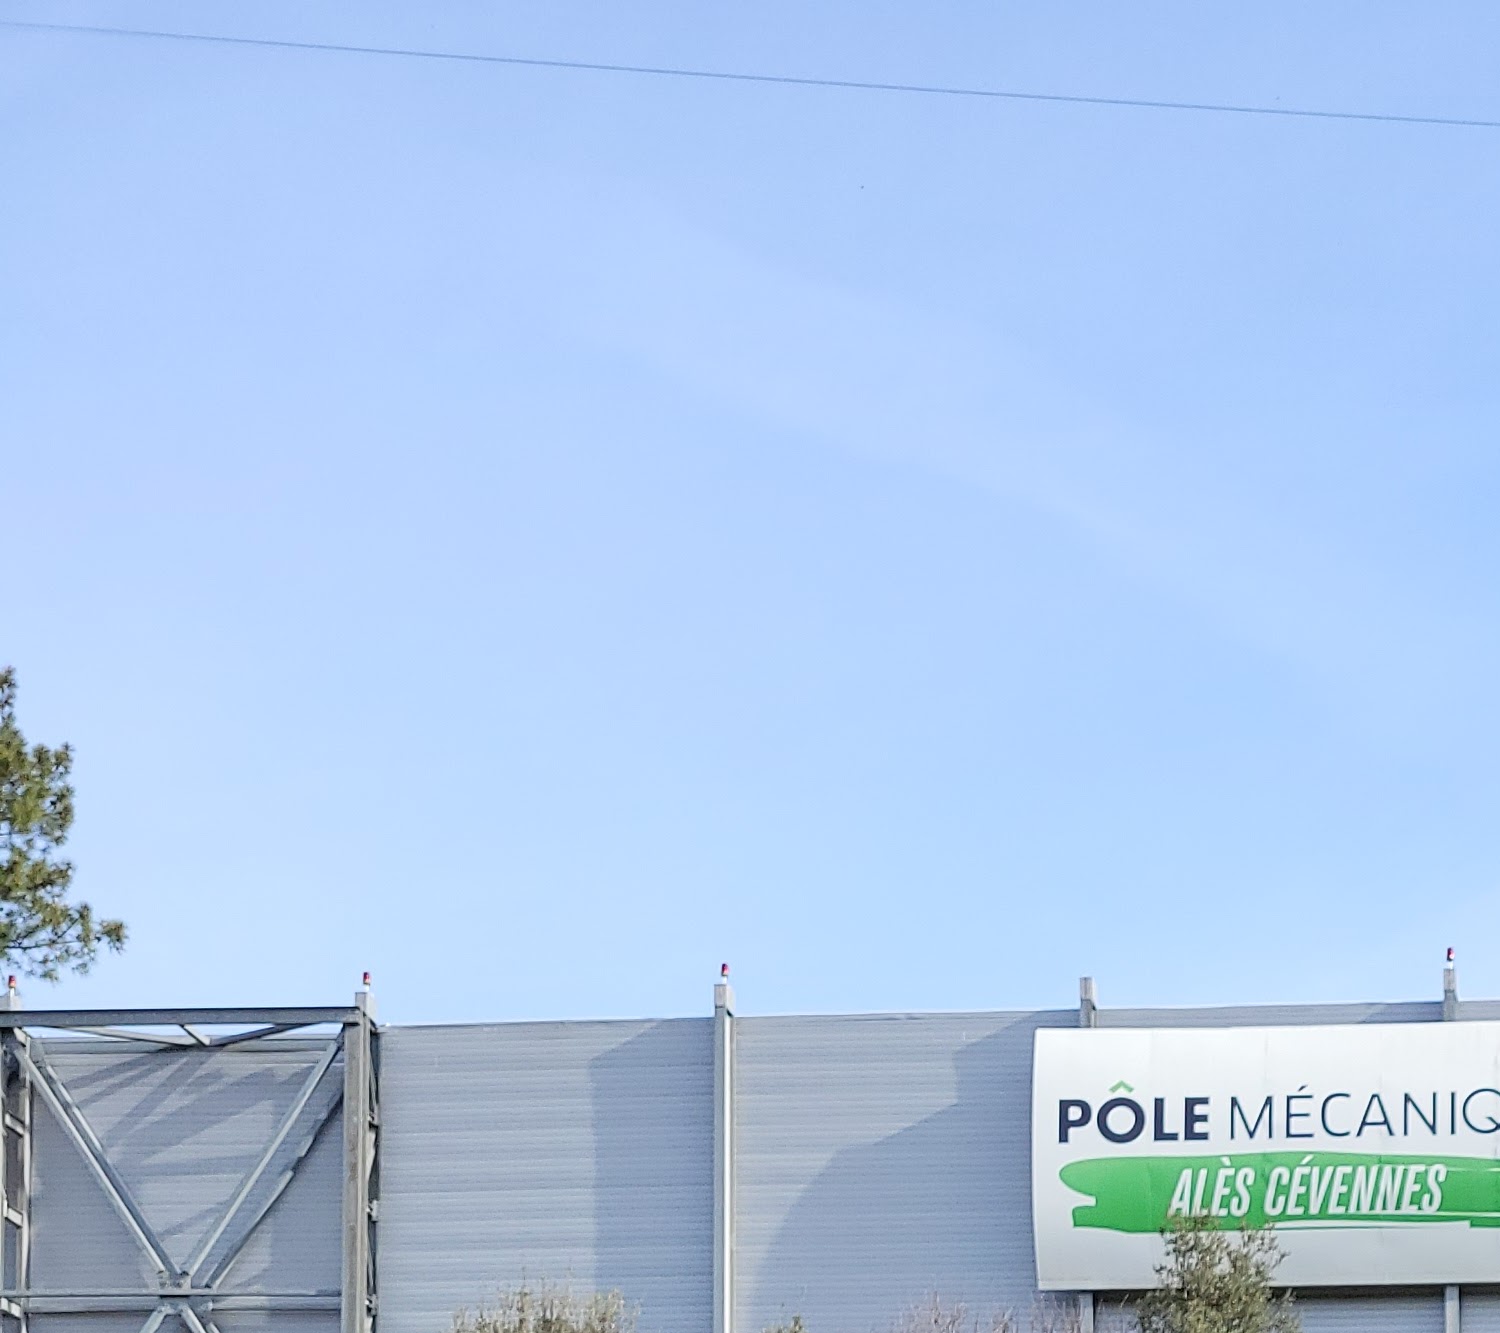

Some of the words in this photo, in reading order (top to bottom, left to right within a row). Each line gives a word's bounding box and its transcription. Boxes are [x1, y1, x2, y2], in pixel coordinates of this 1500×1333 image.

[1058, 1080, 1209, 1143] PÔLE
[1167, 1156, 1256, 1218] ALÈS
[1262, 1154, 1448, 1216] CÉVENNES
